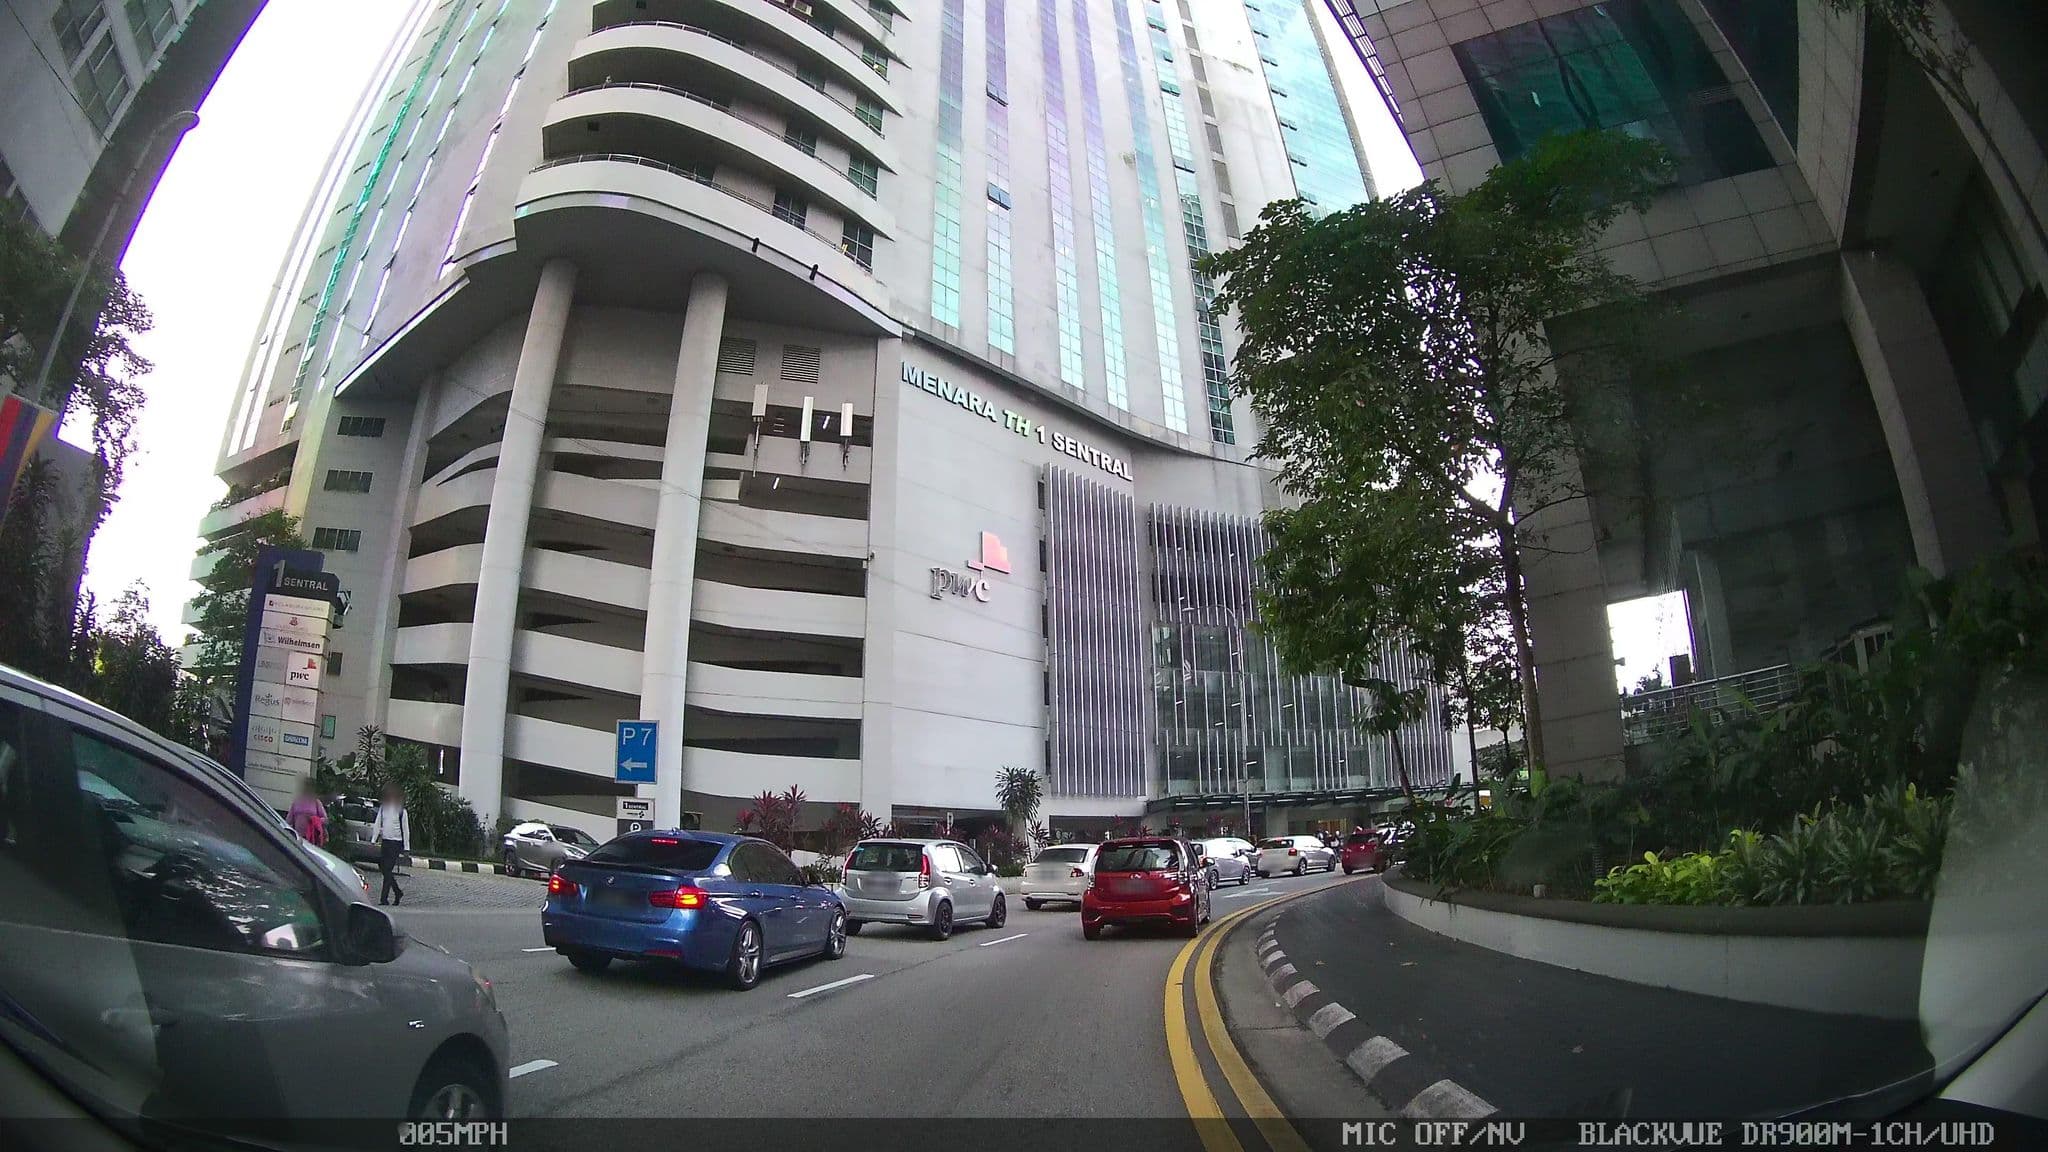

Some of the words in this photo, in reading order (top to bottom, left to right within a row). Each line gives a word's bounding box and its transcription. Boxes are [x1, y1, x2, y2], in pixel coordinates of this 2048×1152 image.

[902, 361, 997, 422] MENARA
[1003, 409, 1031, 437] TH
[1035, 425, 1046, 444] 1
[1052, 432, 1133, 481] SENTRAL
[273, 559, 286, 588] 1
[284, 577, 329, 591] SENTRAL
[930, 566, 991, 602] pwc
[278, 636, 321, 649] Wilhelmsen
[290, 671, 310, 681] pwc
[253, 734, 273, 743] cisco
[622, 727, 636, 745] P
[641, 728, 652, 746] 7
